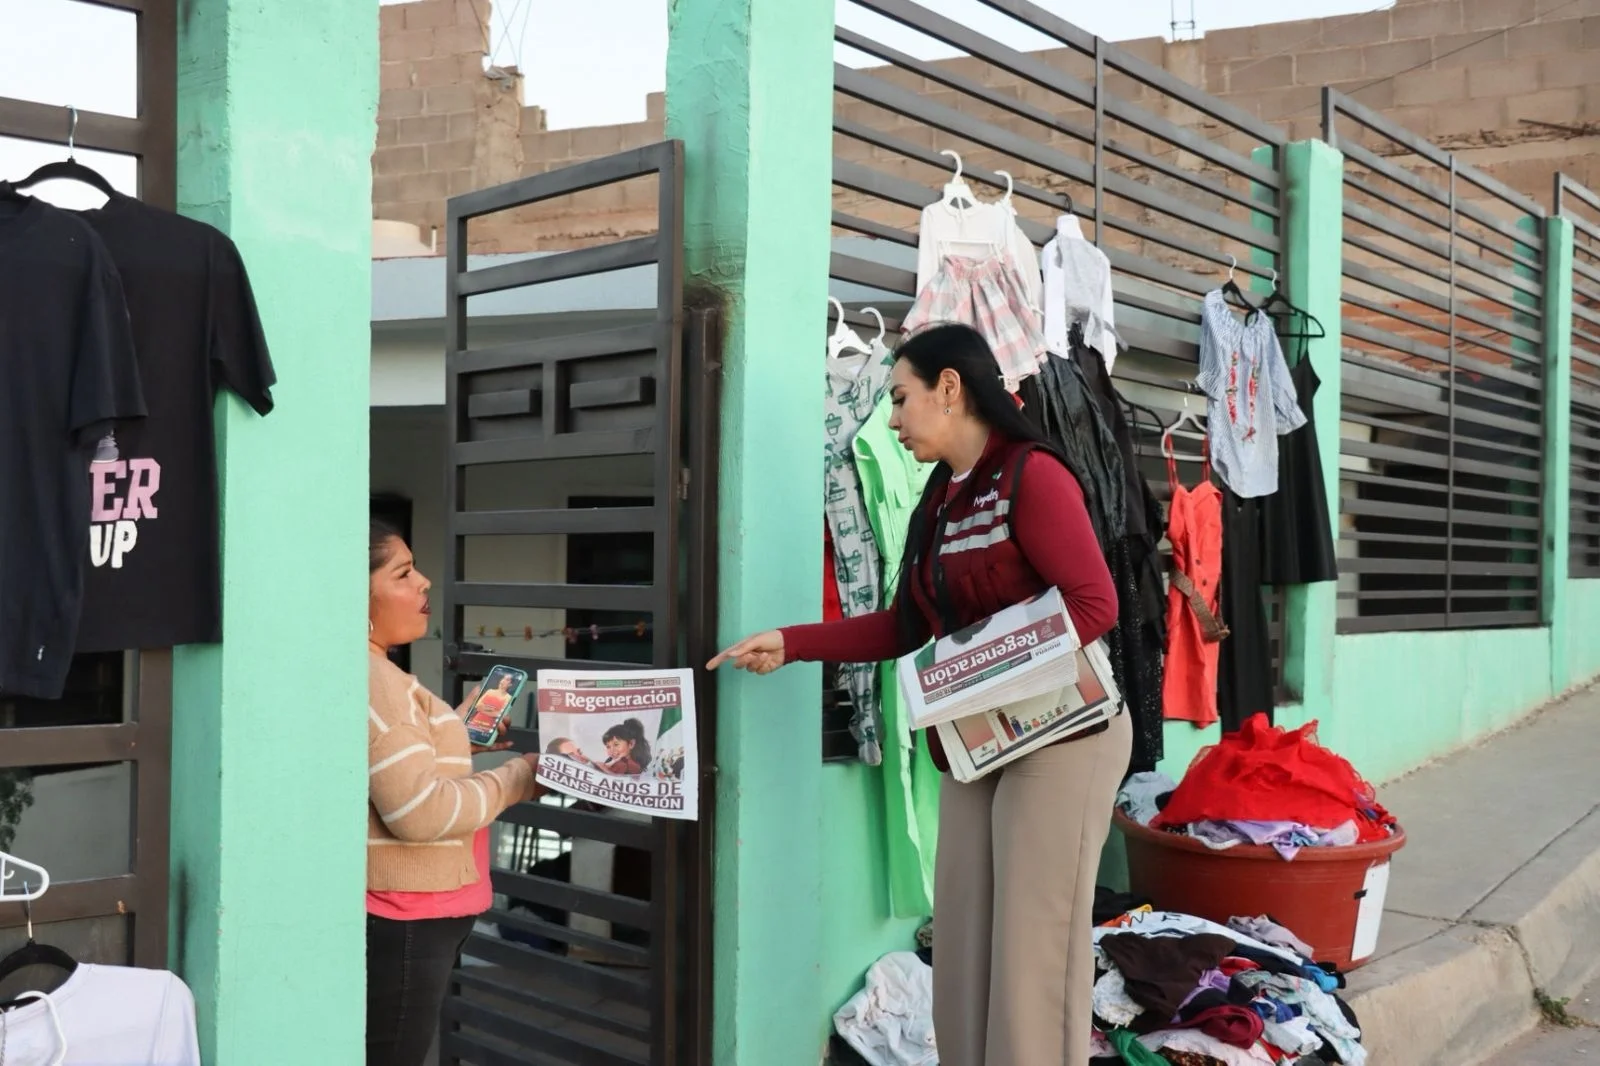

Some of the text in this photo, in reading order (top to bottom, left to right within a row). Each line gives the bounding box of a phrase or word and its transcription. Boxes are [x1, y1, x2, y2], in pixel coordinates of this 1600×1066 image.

[89, 458, 161, 521] ER
[89, 520, 138, 568] UP
[924, 630, 1039, 687] Regeneración
[565, 690, 677, 711] Regeneración
[540, 767, 682, 809] TRANSFORMACIÓN
[545, 756, 595, 782] SIETE
[658, 781, 682, 796] DE
